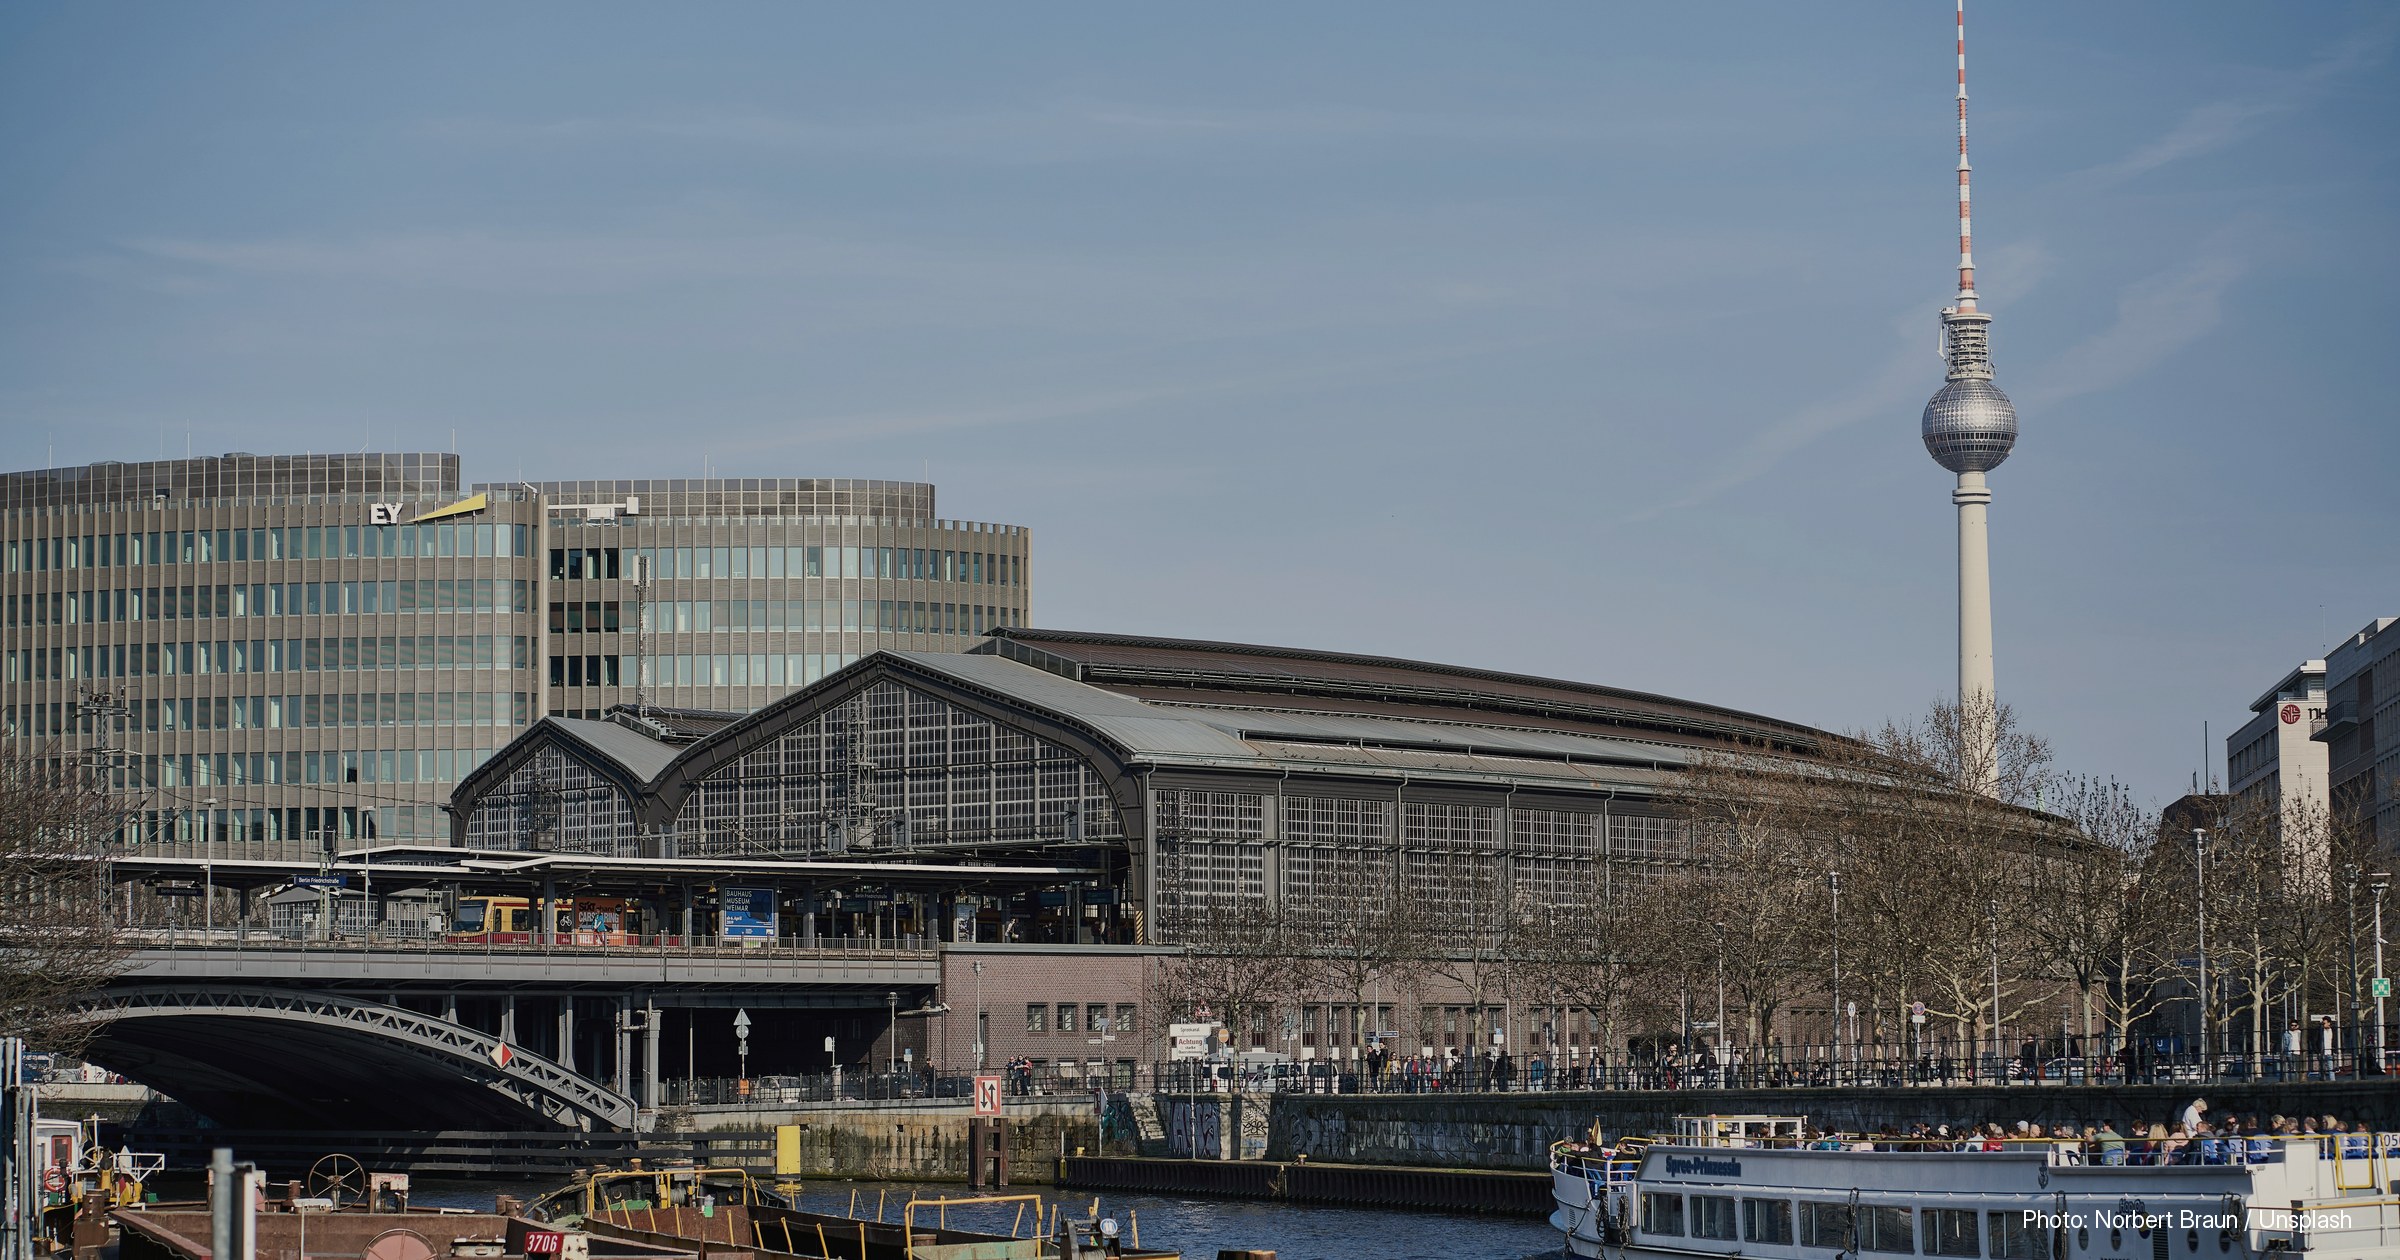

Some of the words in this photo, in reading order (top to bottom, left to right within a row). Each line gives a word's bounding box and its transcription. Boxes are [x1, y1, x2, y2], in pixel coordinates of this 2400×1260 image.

[370, 503, 404, 524] EY
[726, 890, 752, 898] BAUHAUS
[726, 897, 750, 905] MUSEUM
[726, 904, 749, 912] WEIMAR
[1178, 1038, 1203, 1047] Achtung
[2383, 1134, 2400, 1147] 05
[1665, 1155, 1742, 1178] Spree-Prinzessin
[527, 1234, 558, 1252] 3706
